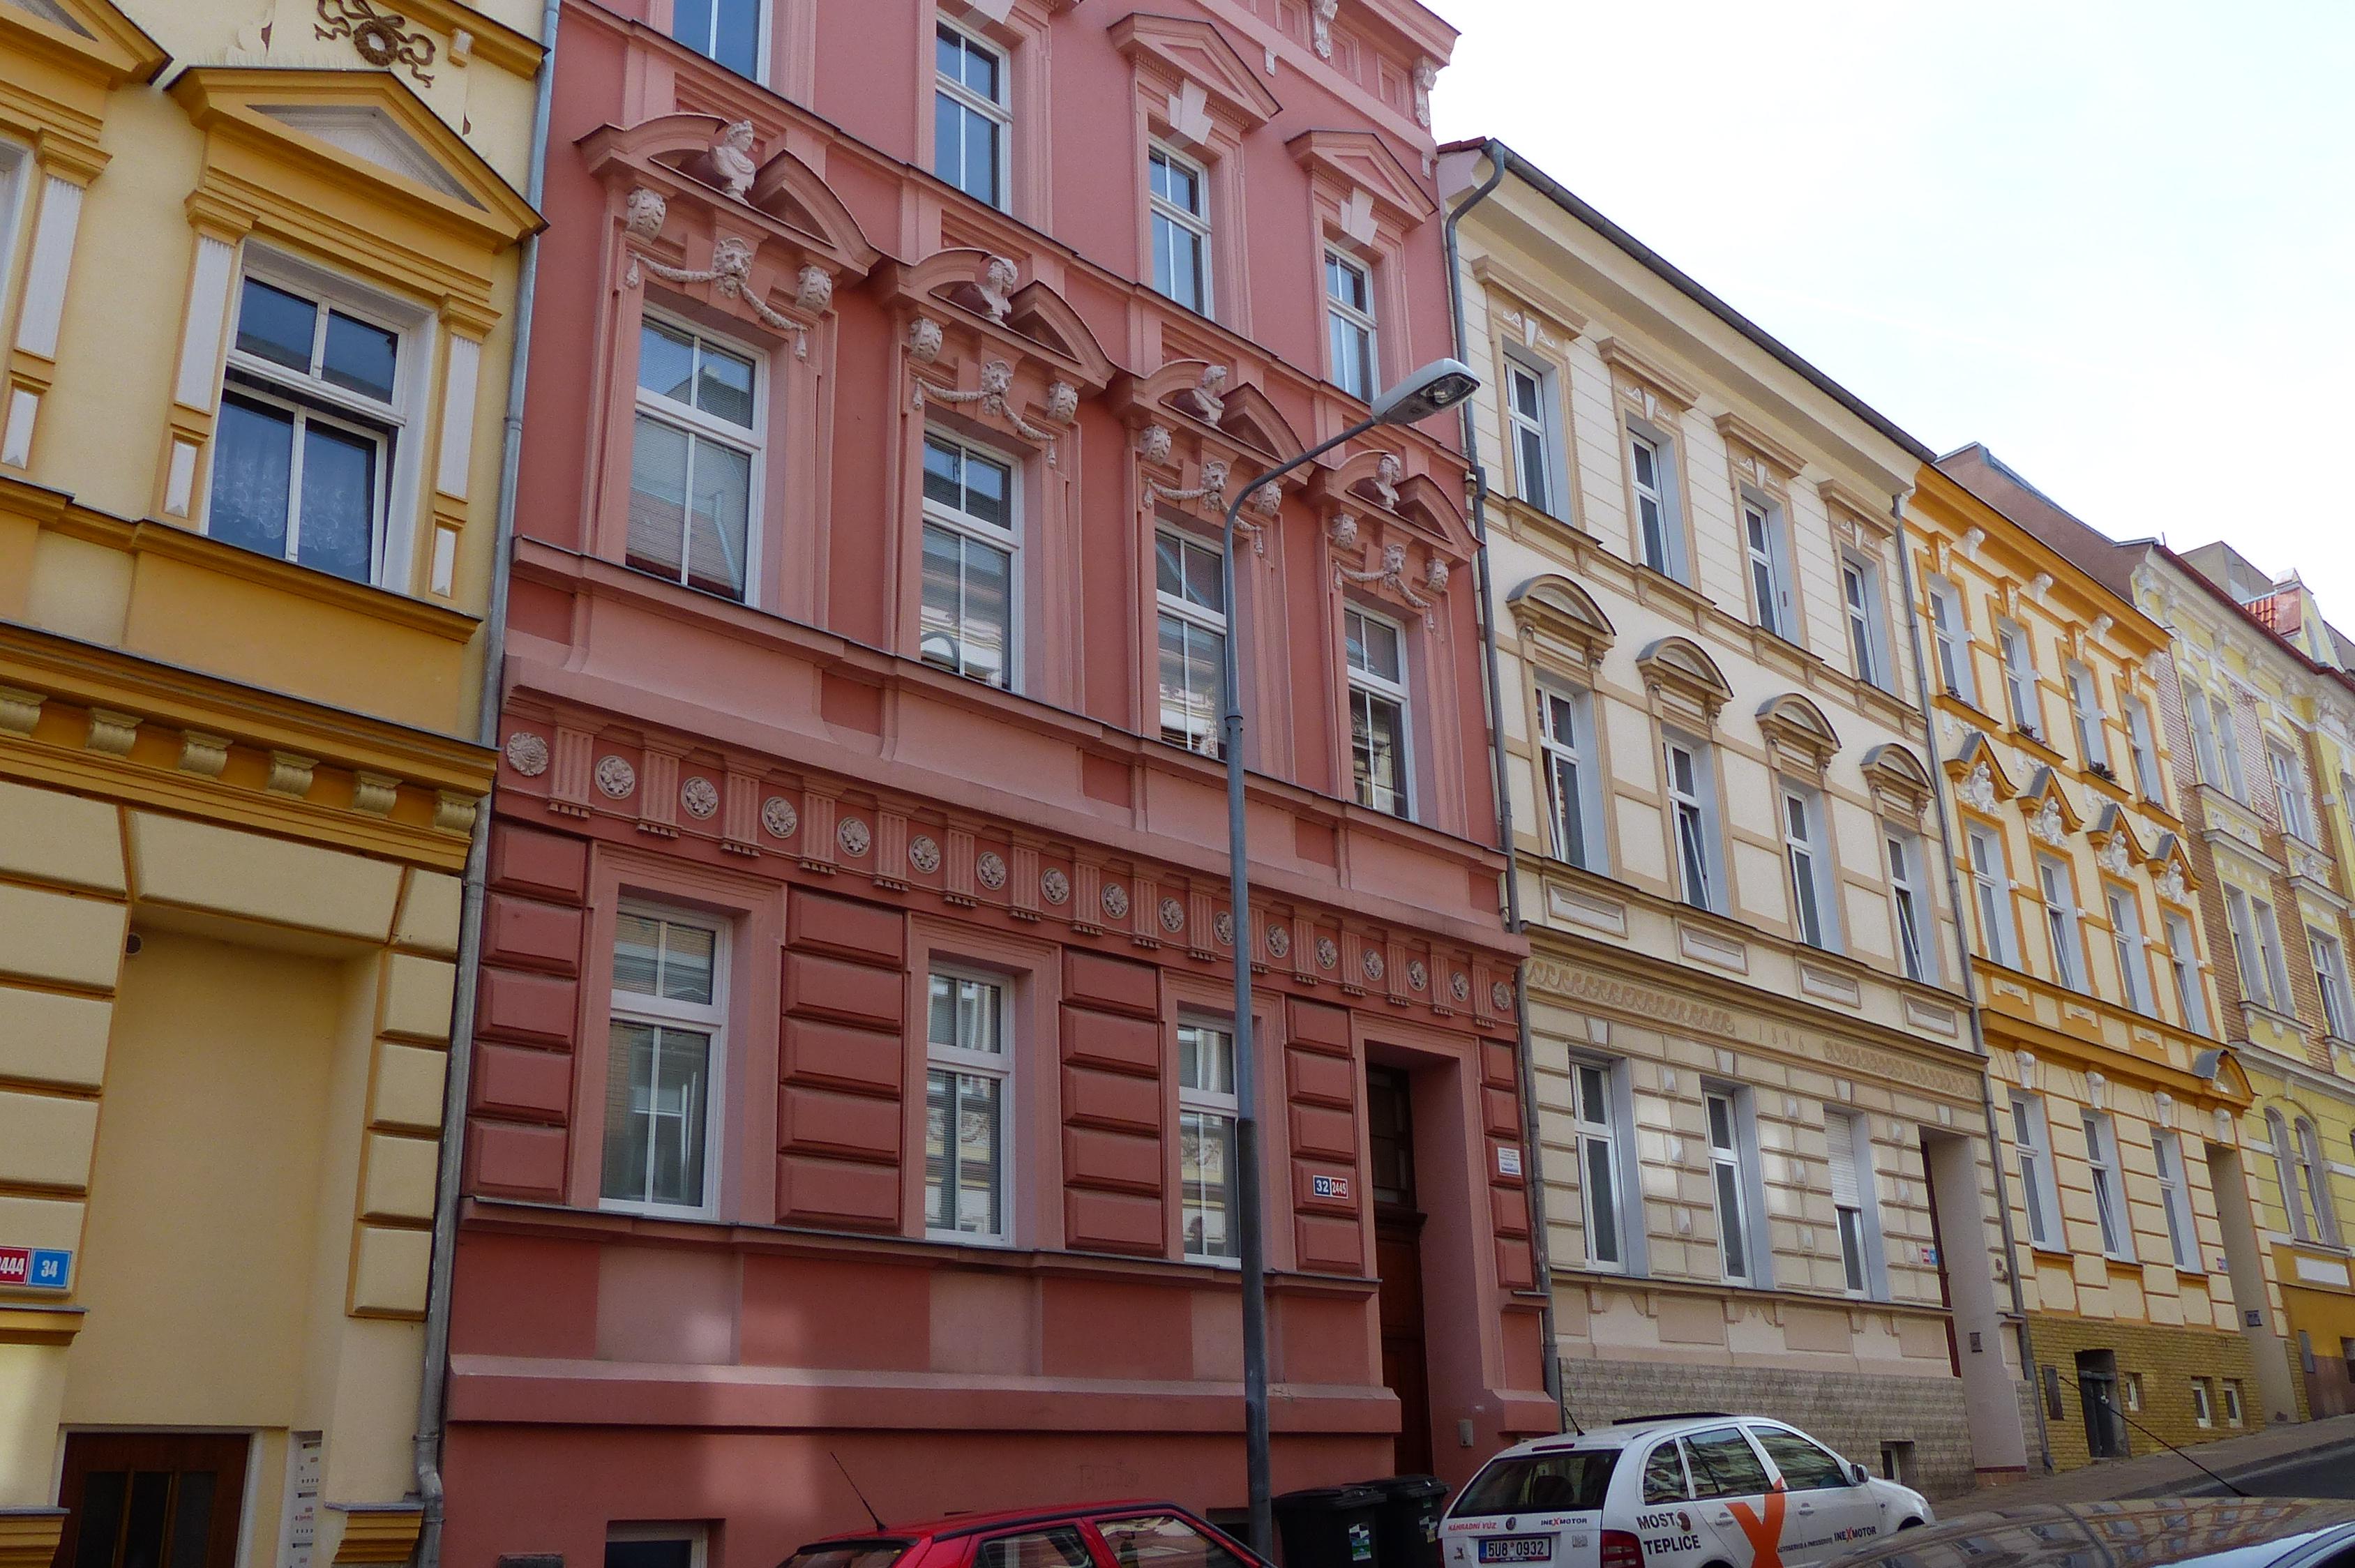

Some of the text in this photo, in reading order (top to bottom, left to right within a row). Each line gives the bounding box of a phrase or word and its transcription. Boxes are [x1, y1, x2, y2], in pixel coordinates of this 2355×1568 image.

[1759, 1023, 1804, 1052] 1896
[1316, 1179, 1347, 1195] 32 2445
[0, 1256, 59, 1278] 444 34
[1541, 1517, 1587, 1527] INEXMOTOR
[1636, 1512, 1674, 1530] MOST
[1834, 1525, 1877, 1544] INEXMOTOR
[1489, 1541, 1544, 1557] 5U8 0932
[1643, 1535, 1701, 1555] TEPLICE
